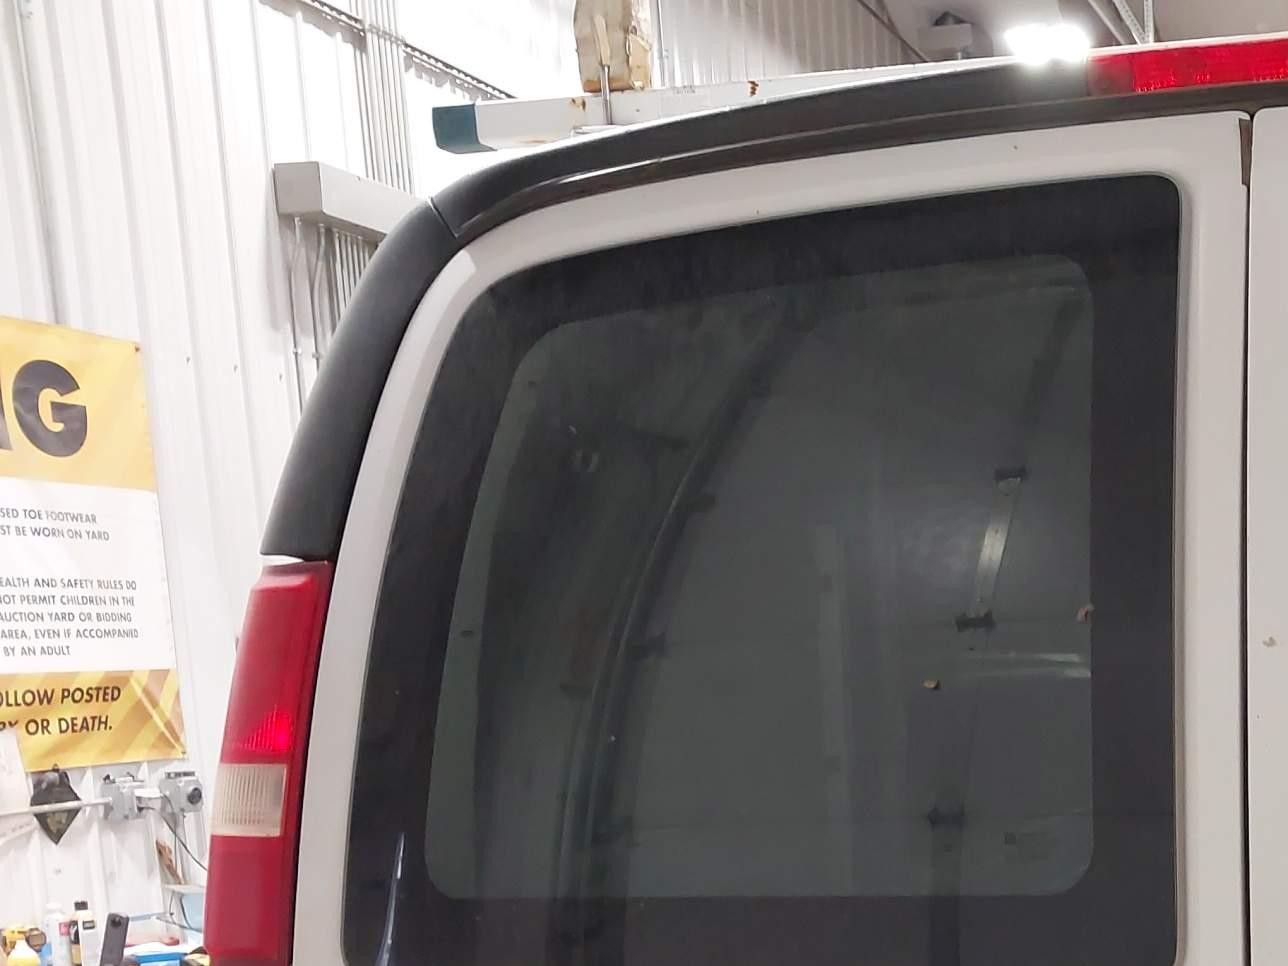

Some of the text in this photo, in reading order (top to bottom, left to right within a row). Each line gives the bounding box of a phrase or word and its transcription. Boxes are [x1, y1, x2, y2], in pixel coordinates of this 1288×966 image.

[22, 509, 43, 520] TOE
[45, 511, 97, 523] FOOTWEAR
[0, 525, 110, 541] ST BE WORN ON YARD
[33, 578, 57, 588] AND
[60, 578, 94, 590] SAFETY
[97, 579, 123, 590] RULES
[126, 580, 137, 590] DO
[20, 595, 56, 605] PERMIT
[60, 595, 107, 606] CHILDREN
[109, 596, 119, 606] IN
[122, 596, 135, 607] THE
[48, 612, 75, 623] YARD
[79, 612, 93, 623] OR
[96, 612, 132, 623] BIDDING
[1, 628, 31, 640] AREA,
[34, 628, 60, 639] EVEN
[64, 629, 72, 639] IF
[3, 645, 70, 656] BY AN ADULT
[60, 686, 121, 704] POSTED
[25, 718, 51, 735] OR
[58, 715, 112, 734] DEATH.
